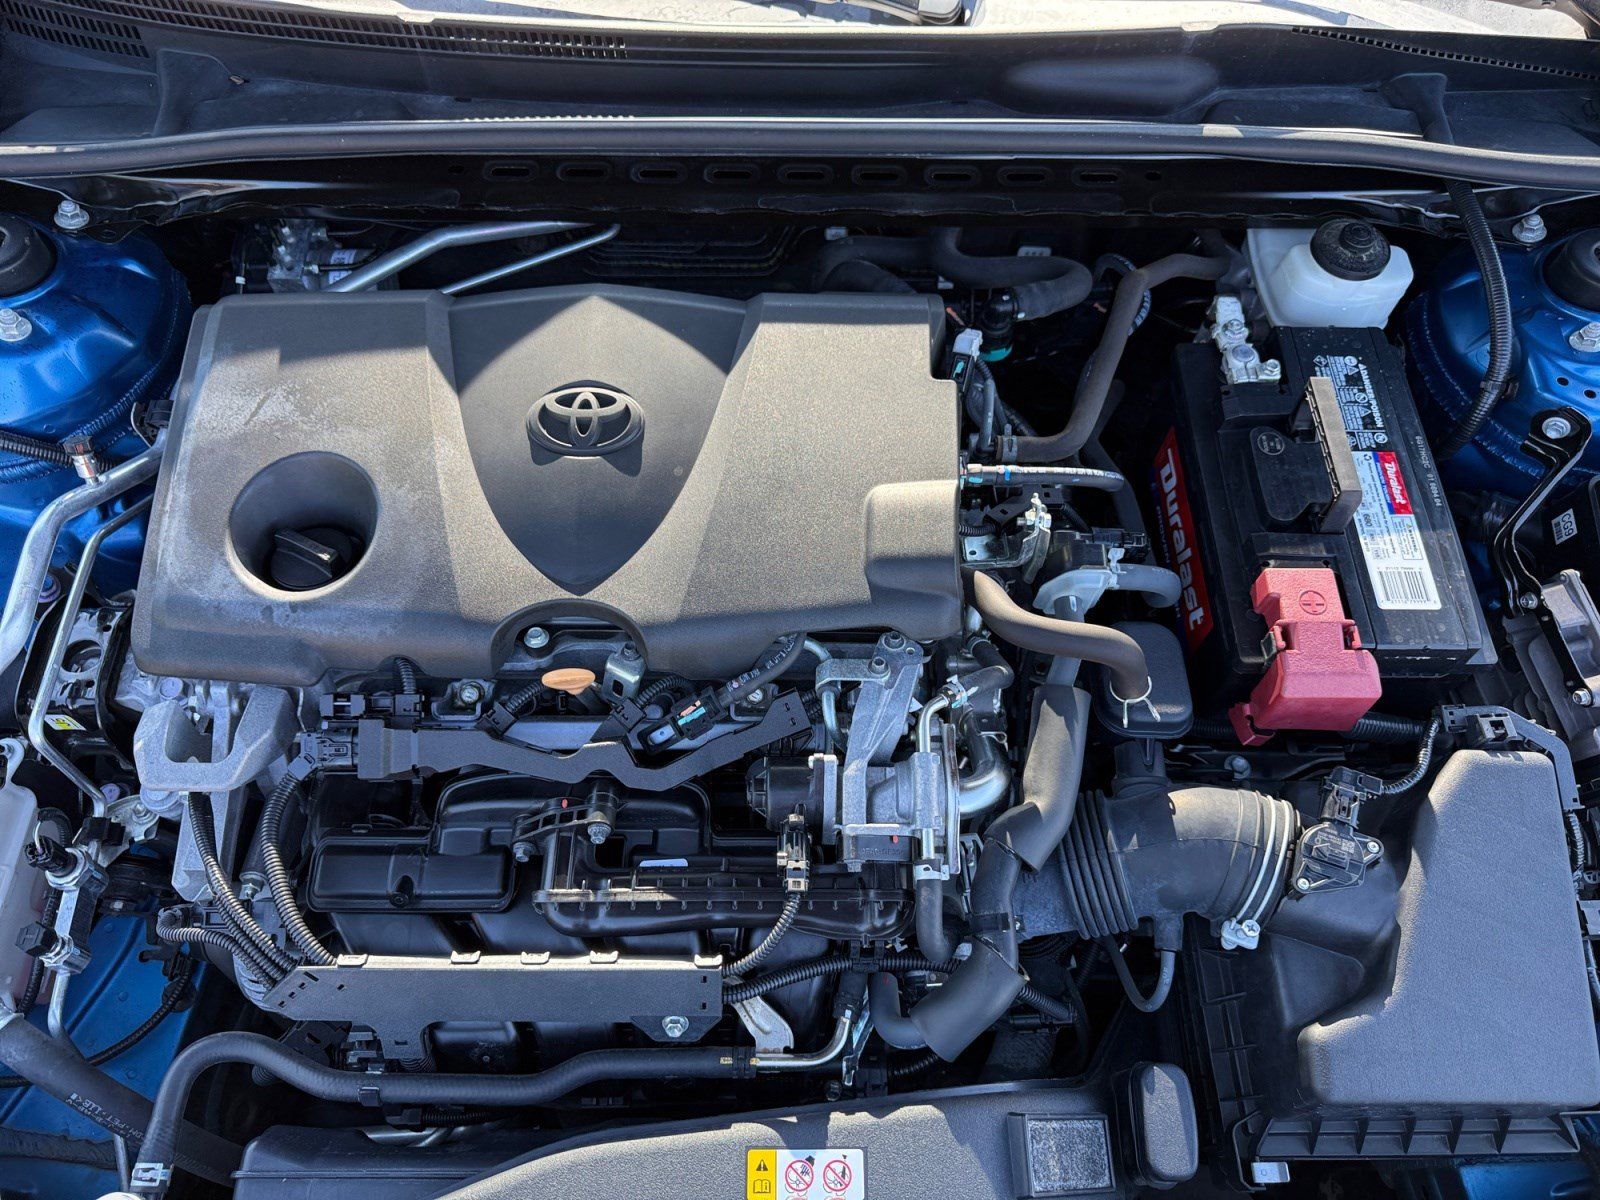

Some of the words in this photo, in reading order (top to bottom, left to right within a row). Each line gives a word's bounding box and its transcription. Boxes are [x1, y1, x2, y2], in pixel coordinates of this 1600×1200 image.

[1385, 461, 1406, 504] Duralast
[1160, 447, 1206, 628] Duralast
[1562, 513, 1574, 536] CG9
